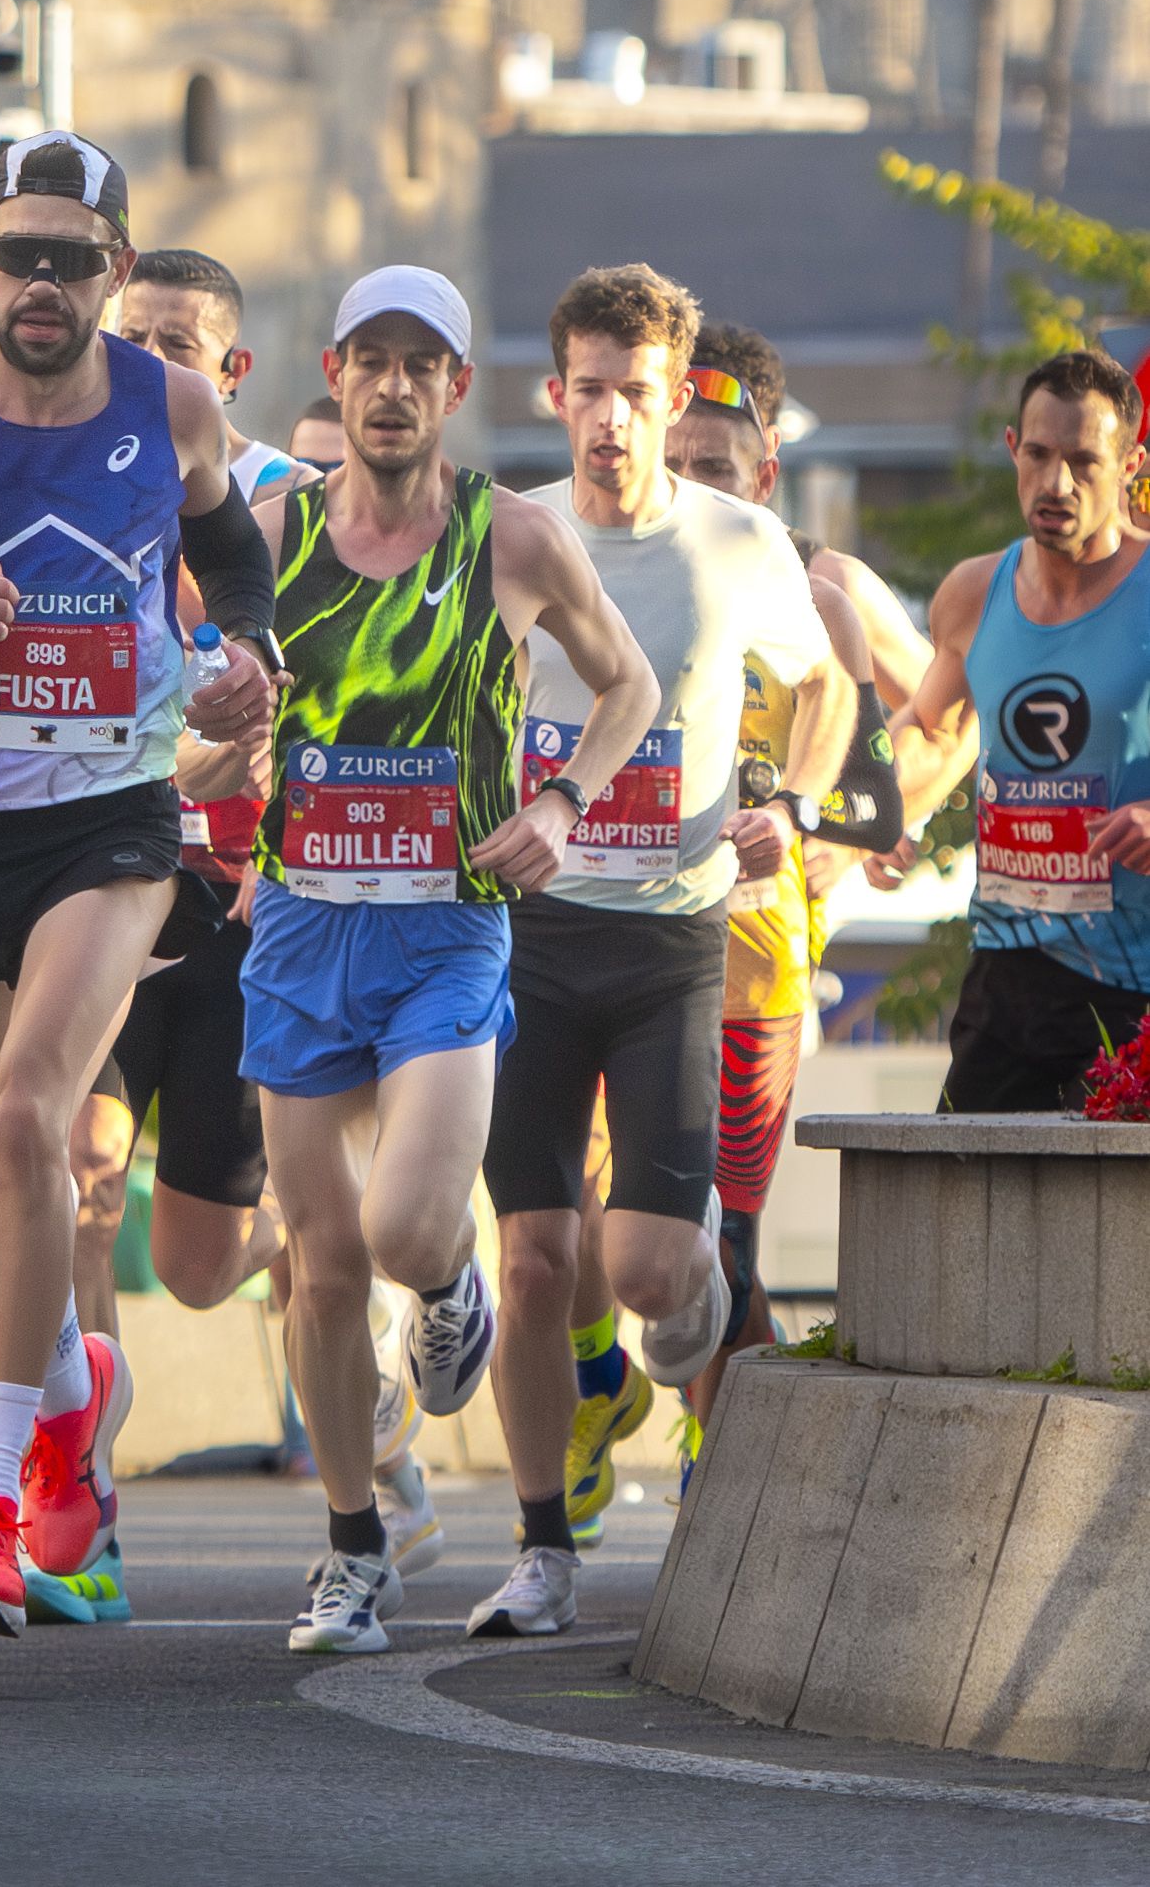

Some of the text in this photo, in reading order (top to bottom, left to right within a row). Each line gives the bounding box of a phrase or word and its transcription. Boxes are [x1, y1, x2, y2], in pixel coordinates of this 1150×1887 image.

[18, 594, 114, 614] ZURICH
[26, 642, 66, 665] 898
[338, 757, 433, 776] ZURICH
[1006, 782, 1088, 800] ZURICH
[347, 802, 385, 823] 903
[303, 825, 433, 865] GUILLÉN
